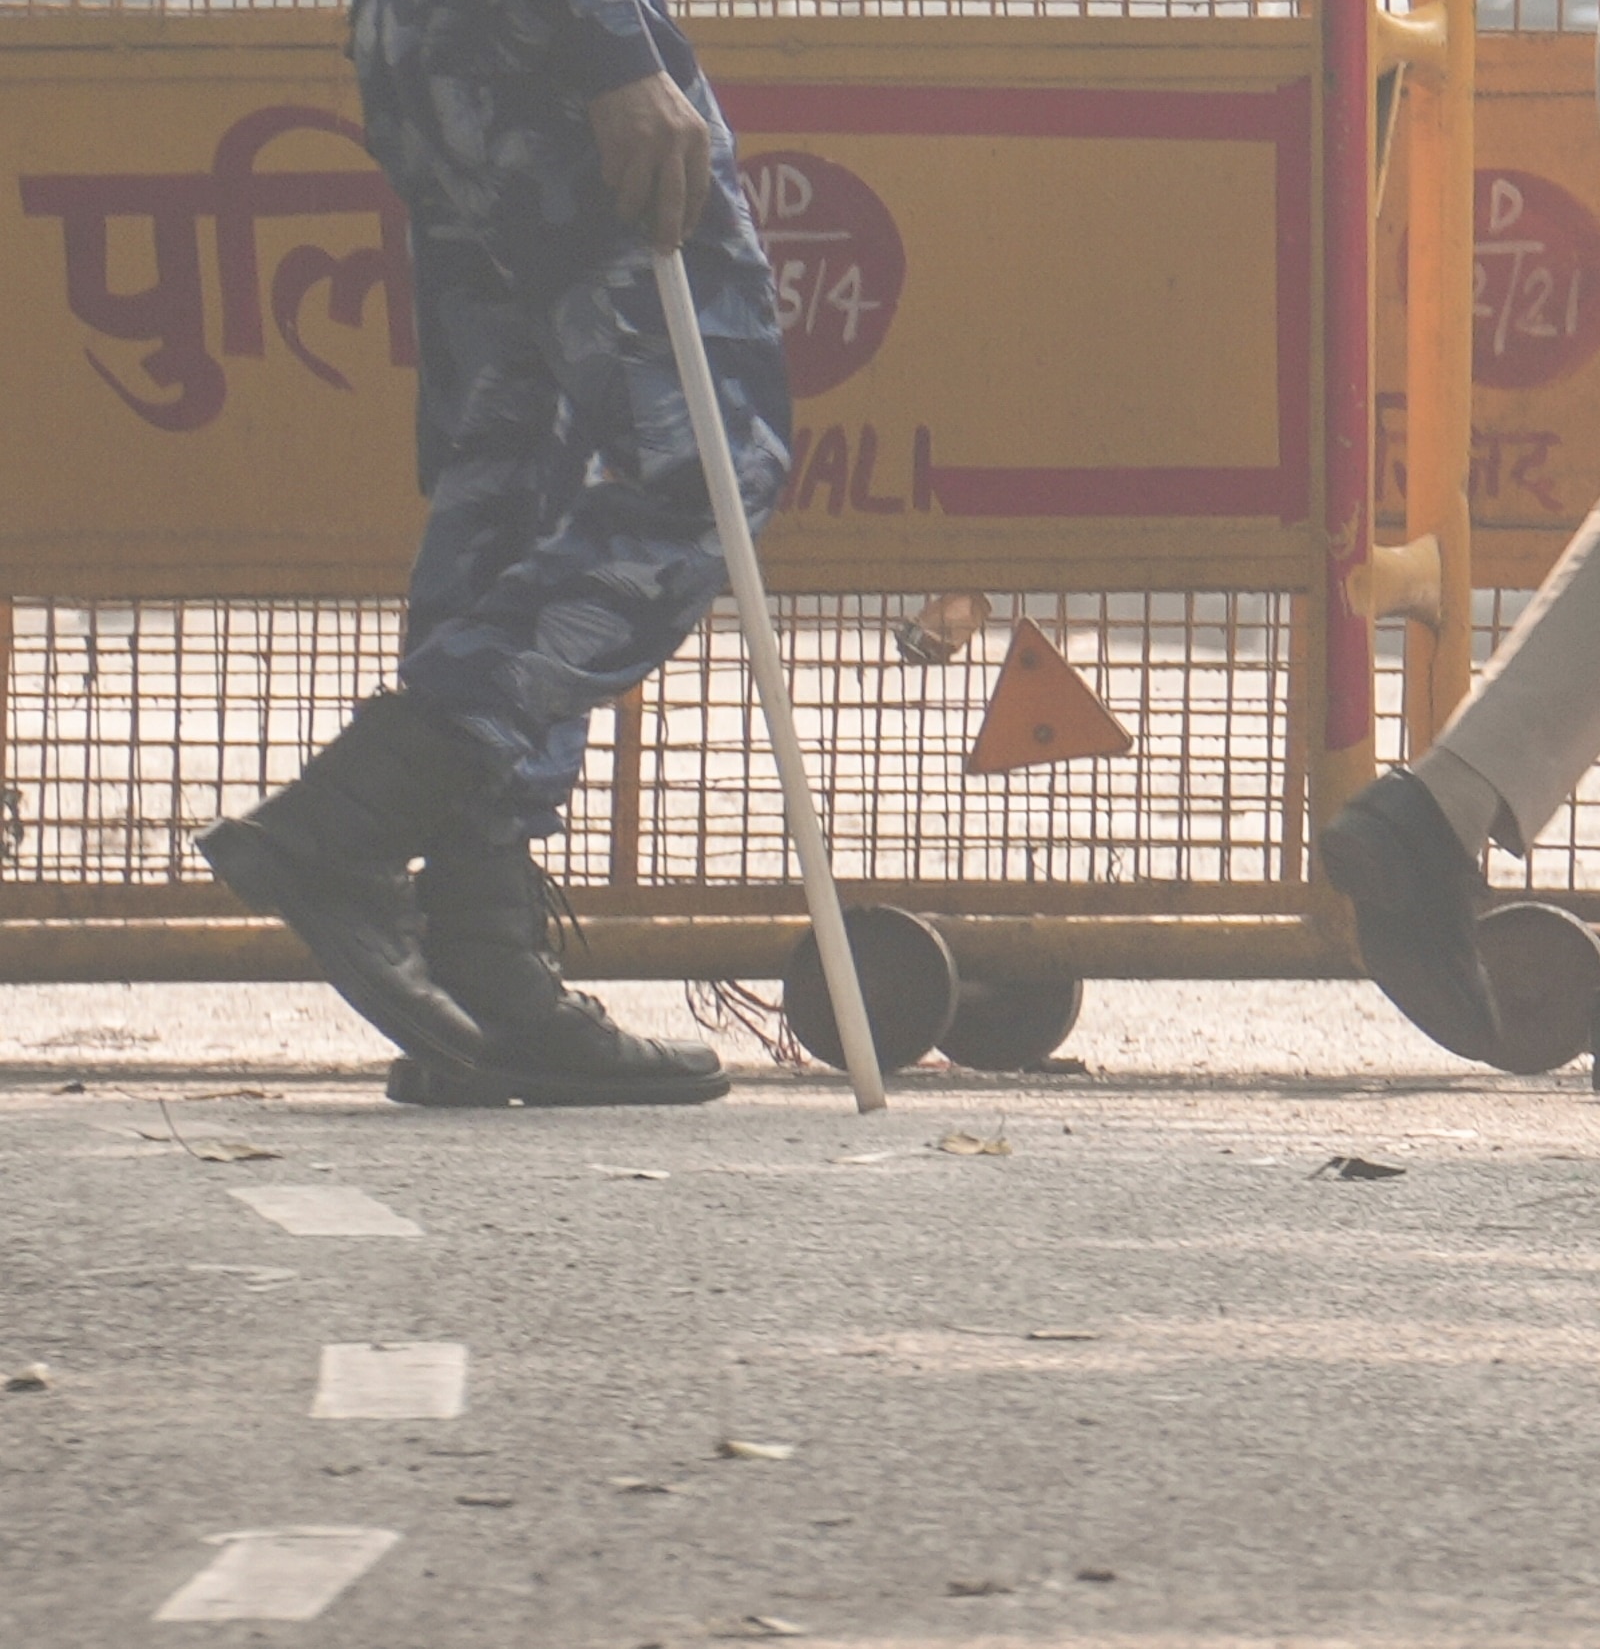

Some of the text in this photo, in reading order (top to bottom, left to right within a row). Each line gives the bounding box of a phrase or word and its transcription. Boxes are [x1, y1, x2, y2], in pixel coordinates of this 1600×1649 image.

[1490, 179, 1524, 231] D
[19, 106, 418, 431] पुलि
[776, 257, 882, 344] 5/4
